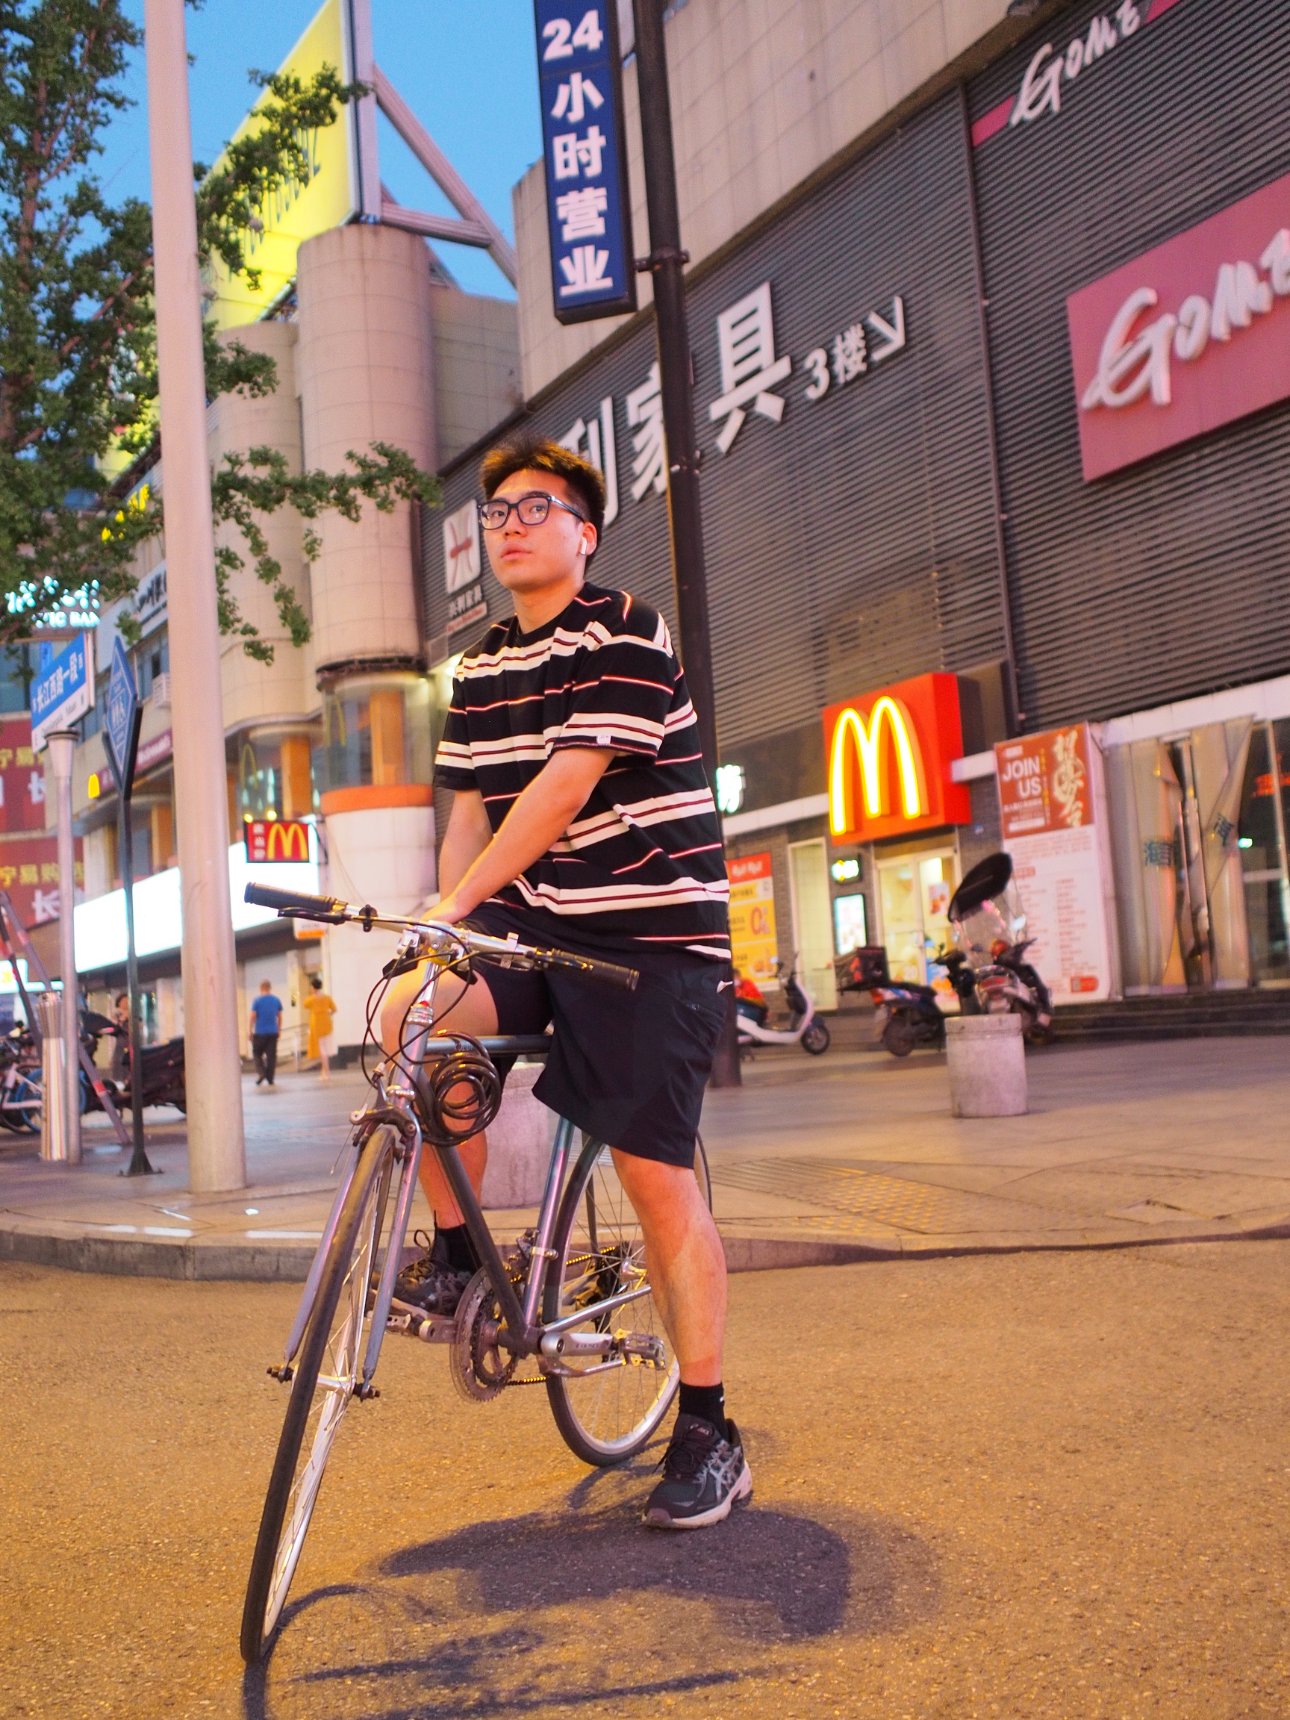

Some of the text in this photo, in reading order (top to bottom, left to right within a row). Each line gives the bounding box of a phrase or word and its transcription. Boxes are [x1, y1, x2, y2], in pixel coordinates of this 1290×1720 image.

[542, 10, 613, 296] 24小时营业
[1002, 755, 1040, 782] JOIN
[1018, 776, 1042, 798] US
